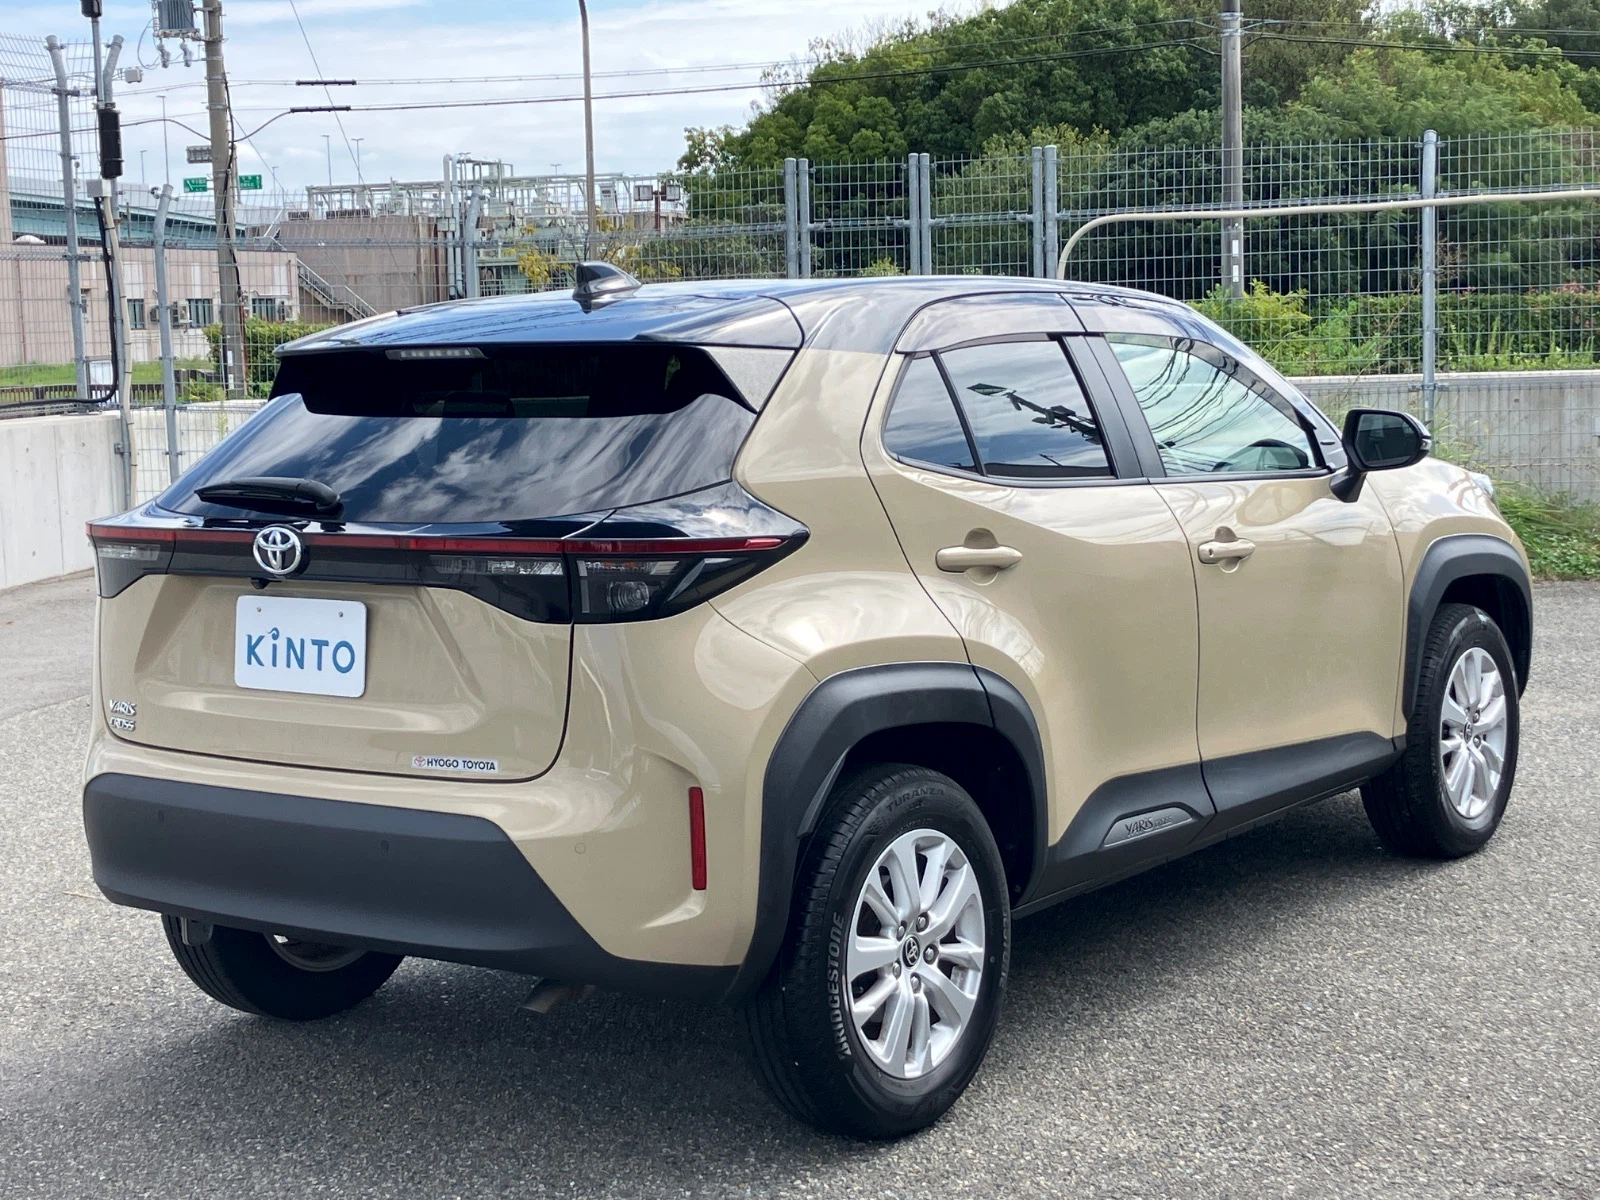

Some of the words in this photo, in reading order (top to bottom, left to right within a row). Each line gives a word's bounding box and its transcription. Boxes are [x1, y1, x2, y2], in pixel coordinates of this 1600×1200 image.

[426, 758, 459, 769] HYOGO
[462, 760, 496, 771] TOYOTA
[886, 786, 945, 812] TURANZA
[826, 912, 852, 1060] BRIDGESTONE
